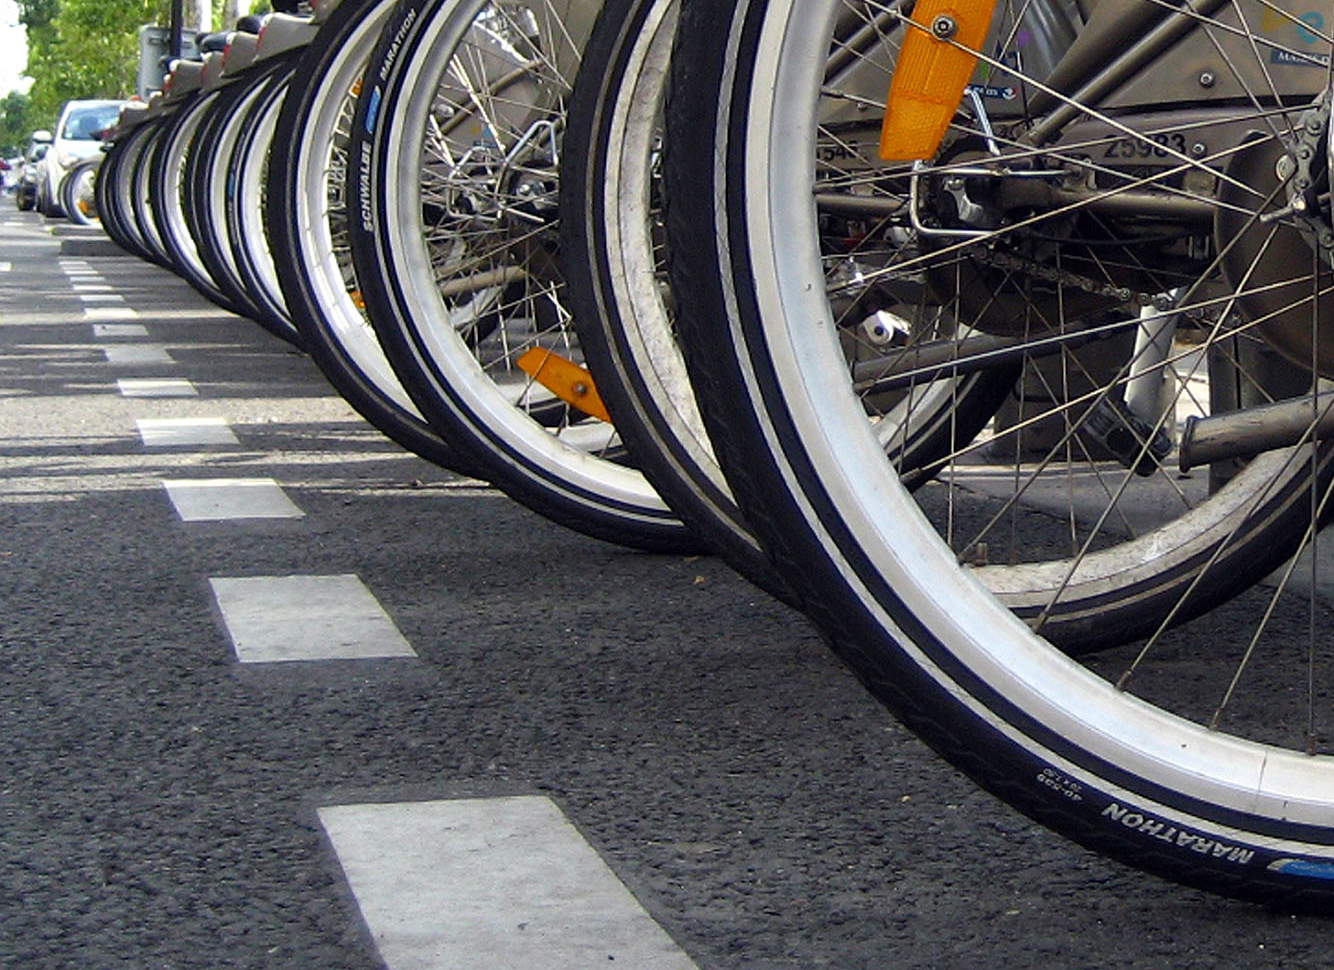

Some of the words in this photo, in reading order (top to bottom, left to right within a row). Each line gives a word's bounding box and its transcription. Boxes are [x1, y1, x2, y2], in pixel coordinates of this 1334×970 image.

[360, 141, 372, 231] SCHWALBE
[380, 8, 416, 81] MARATHON
[1104, 133, 1186, 158] 25983
[1101, 803, 1255, 864] MARATHON
